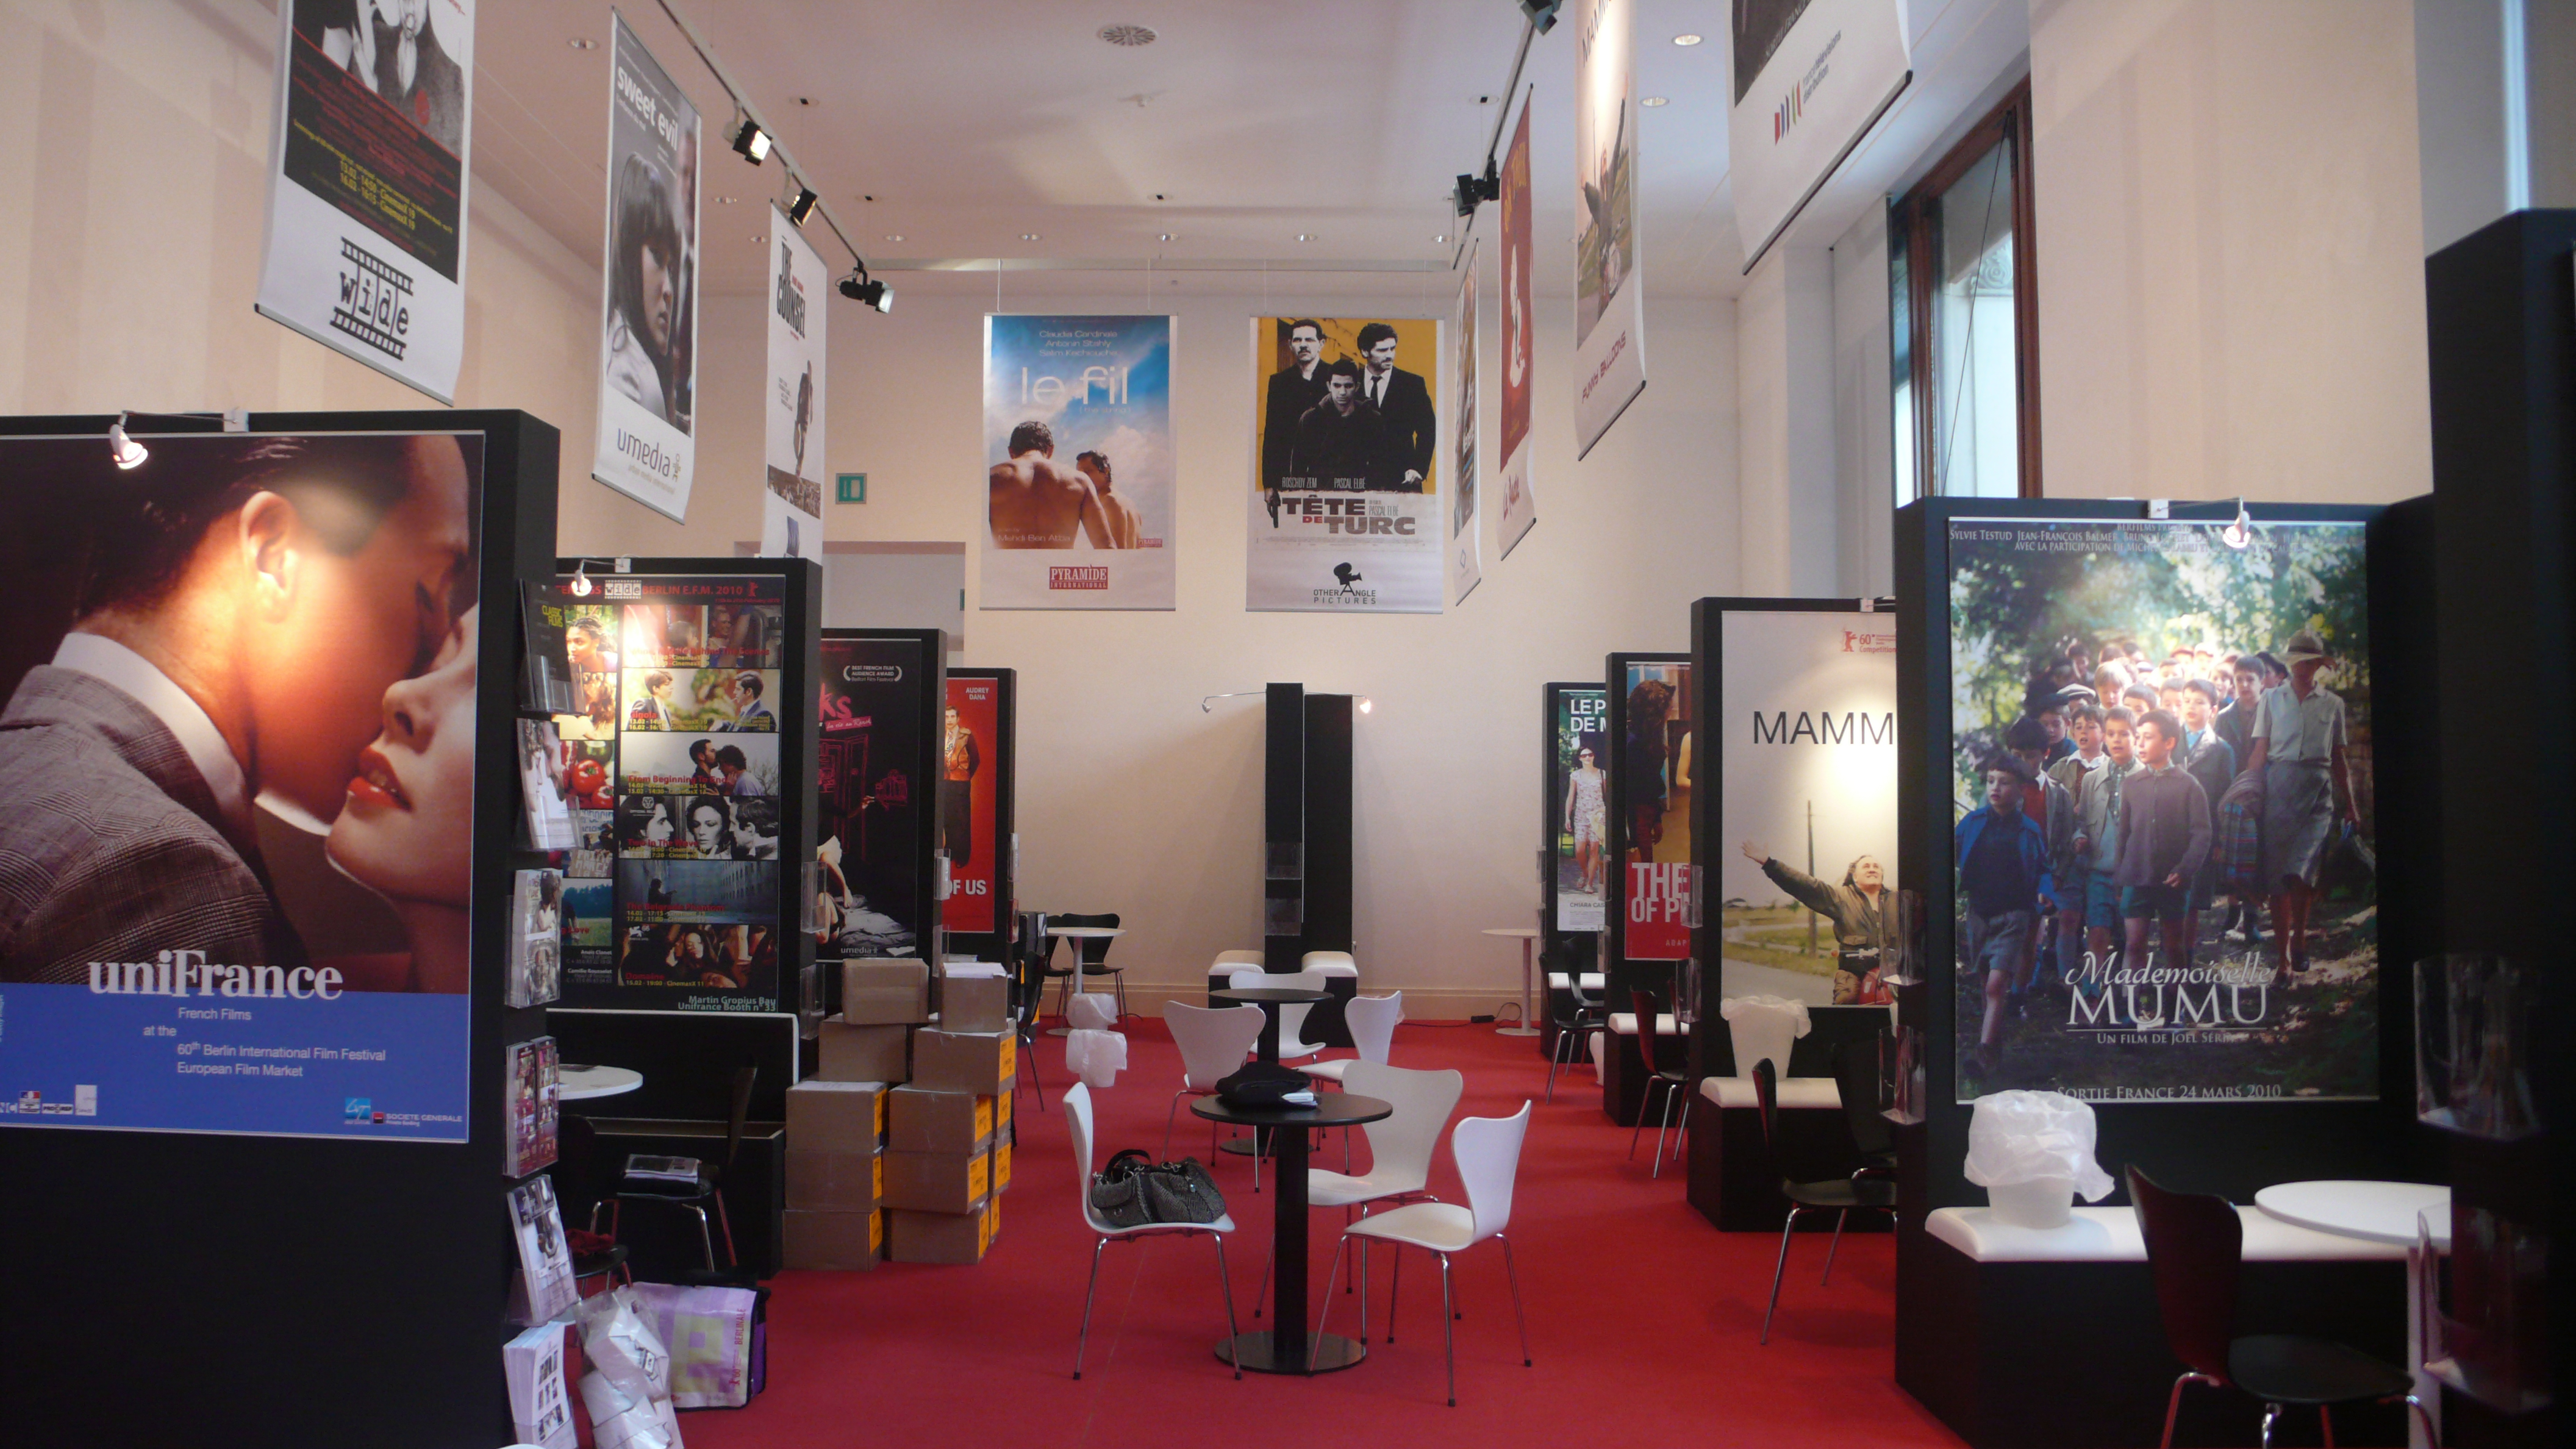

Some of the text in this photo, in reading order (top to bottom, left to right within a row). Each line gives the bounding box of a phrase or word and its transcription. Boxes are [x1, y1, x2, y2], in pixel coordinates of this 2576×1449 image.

[617, 65, 656, 127] sweet
[657, 112, 678, 151] evil
[781, 240, 793, 280] THE
[339, 270, 410, 336] wide
[1075, 329, 1118, 338] Cardinale
[1082, 340, 1112, 348] Stahly
[1021, 365, 1128, 406] le fil
[617, 428, 671, 477] umedia
[1306, 477, 1317, 488] ZEM
[1334, 478, 1352, 489] PASCAL
[1281, 494, 1365, 515] TÊTE
[1368, 505, 1386, 516] PASCAL
[1323, 517, 1415, 535] TURC
[998, 534, 1025, 542] Mehdi
[1950, 529, 2012, 541] SYLVIE TESTUD
[2017, 530, 2083, 543] JEAN-FRANÇOIS
[2015, 542, 2036, 551] AVEC
[2038, 542, 2047, 551] LA
[2049, 542, 2111, 552] PARTICIPATION
[1051, 566, 1107, 581] PYRAMIDE
[642, 585, 681, 595] BERLIN
[682, 585, 714, 595] E.F.M.
[716, 585, 743, 595] 2010
[1570, 699, 1592, 714] LE
[1570, 717, 1595, 732] DE
[653, 775, 696, 785] Beginning
[965, 879, 987, 895] US
[1631, 862, 1690, 900] THE
[1631, 897, 1659, 922] OF
[87, 949, 344, 1001] uniFrance
[2064, 951, 2274, 986] Mademoiselle
[678, 1002, 722, 1011] Unifrance
[723, 1003, 751, 1011] Booth
[689, 995, 757, 1006] Martin Gropius
[2066, 983, 2269, 1025] MUMU
[178, 1007, 252, 1021] French Films
[143, 1025, 177, 1037] at the
[2097, 1032, 2116, 1044] UN
[2120, 1033, 2148, 1043] FILM
[2152, 1033, 2167, 1043] DE
[203, 1044, 237, 1057] Berlin
[239, 1045, 311, 1059] International
[313, 1047, 338, 1059] Film
[341, 1048, 387, 1061] Festival
[177, 1062, 304, 1077] European Film Market
[2057, 1086, 2111, 1098] SORTIE
[2116, 1086, 2175, 1098] FRANCE
[2180, 1085, 2197, 1098] 24
[2247, 1084, 2281, 1097] 2010
[734, 1308, 746, 1345] BERLINALE
